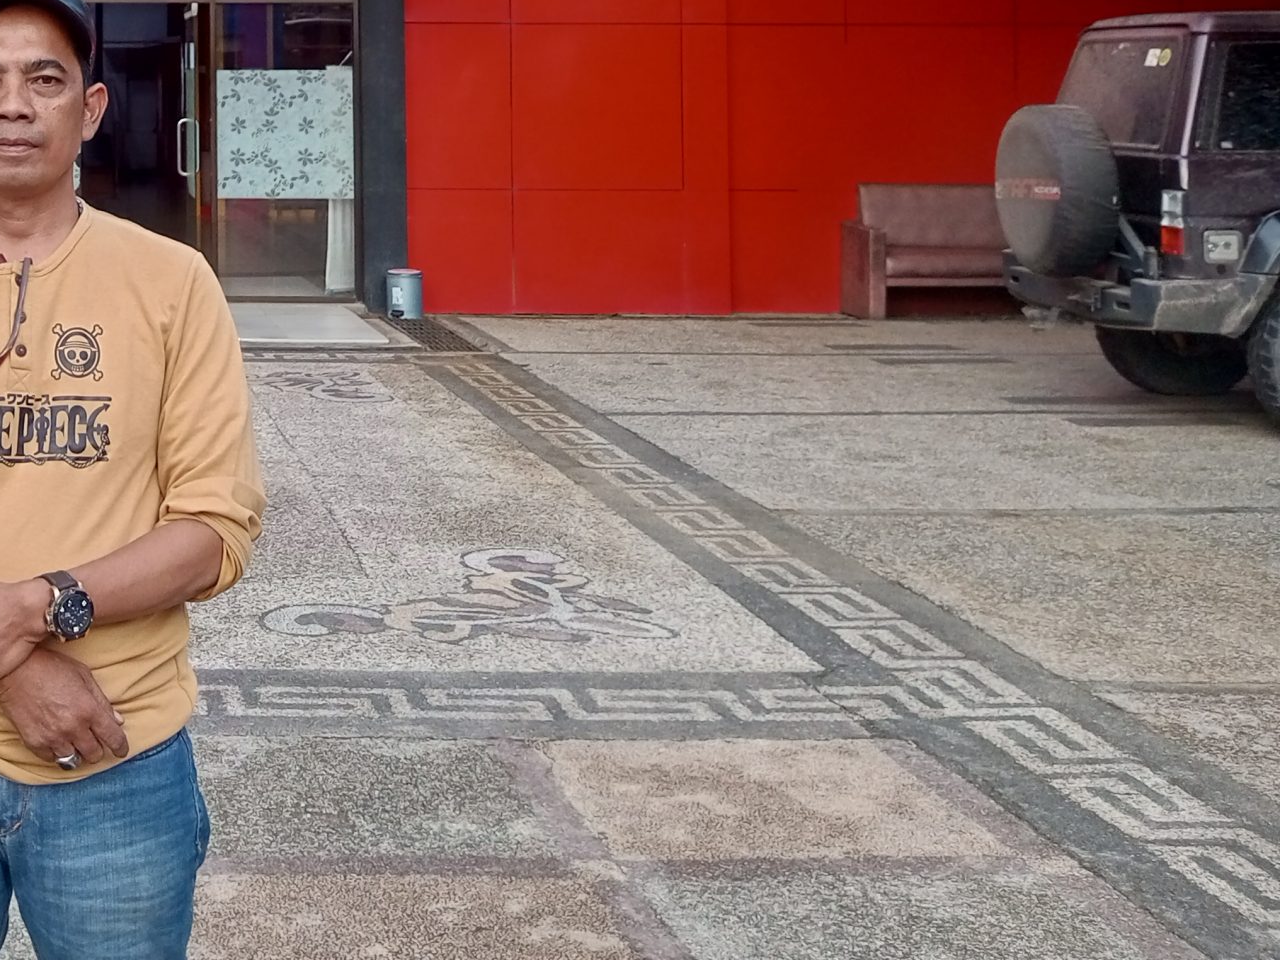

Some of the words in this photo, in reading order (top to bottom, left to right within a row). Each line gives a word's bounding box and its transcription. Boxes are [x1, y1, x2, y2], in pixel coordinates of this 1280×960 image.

[6, 393, 51, 406] ワンピース
